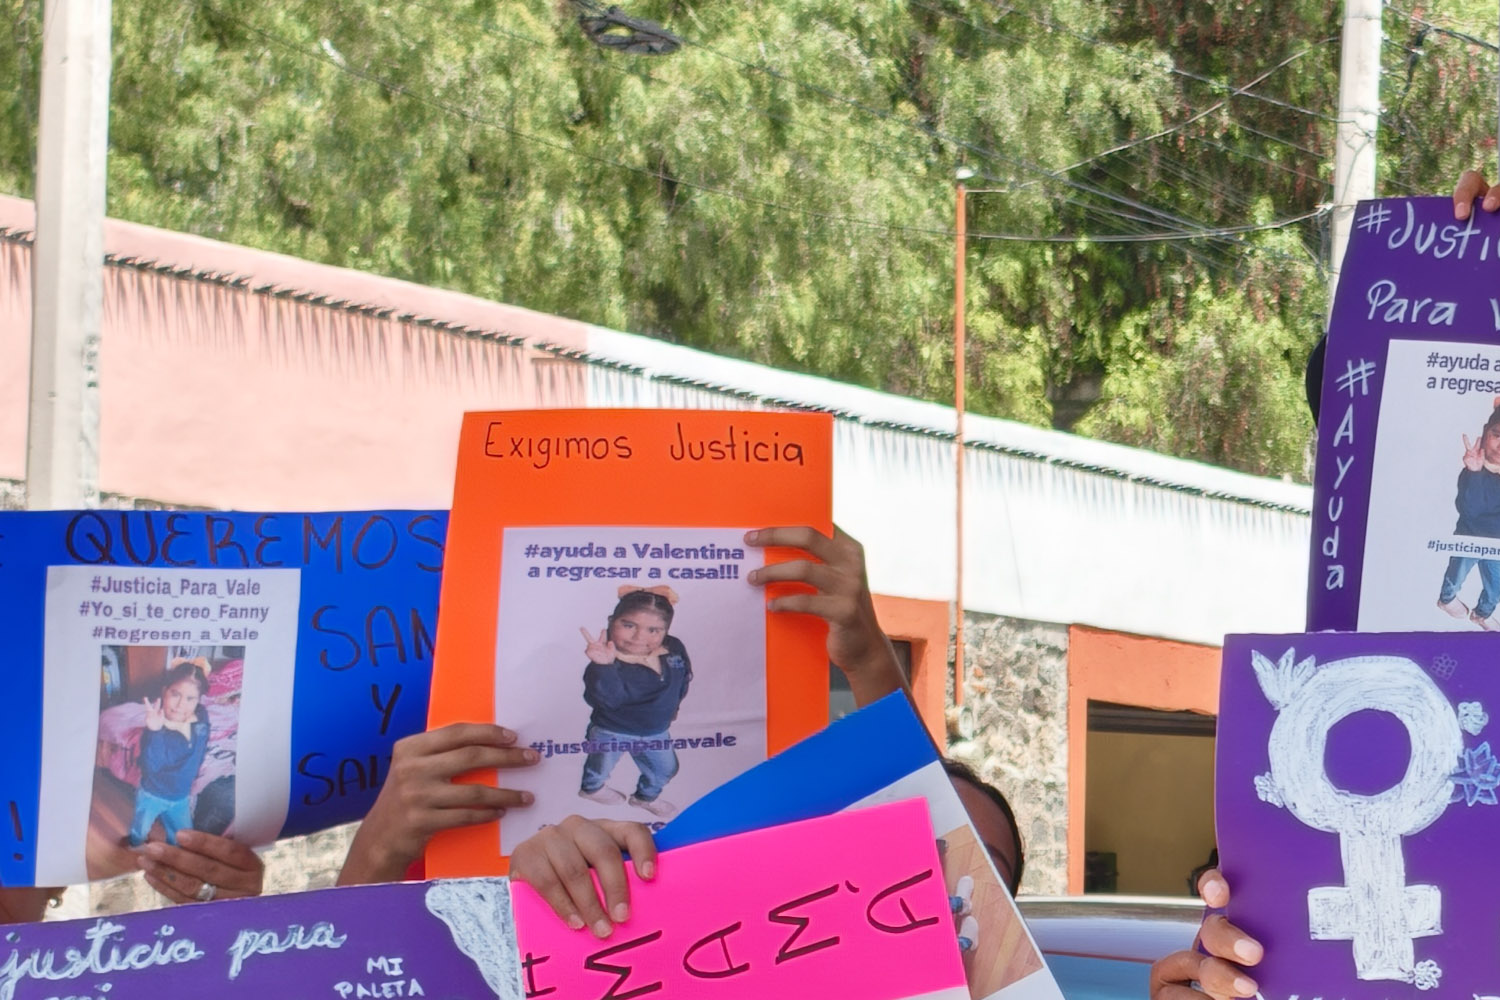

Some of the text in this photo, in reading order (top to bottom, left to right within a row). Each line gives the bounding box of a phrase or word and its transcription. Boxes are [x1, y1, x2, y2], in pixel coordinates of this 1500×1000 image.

[1367, 279, 1459, 326] Para
[1426, 351, 1489, 373] #ayuda
[1426, 376, 1437, 389] a
[484, 421, 805, 470] Exigimos Justicia
[65, 510, 444, 573] QUEREMOS
[524, 542, 745, 562] #ayuda a Valentina
[527, 564, 740, 582] a regresar a casa!!!
[91, 575, 262, 599] #Justicia_Para_Vale
[79, 601, 270, 624] #Yo_si_te_creo_Fanny
[92, 626, 260, 644] #Regresen_a_Vale
[311, 604, 436, 672] SAN
[370, 683, 403, 736] Y
[530, 732, 737, 758] #justiciaparavale
[227, 920, 348, 981] para
[365, 955, 405, 977] MI
[333, 977, 425, 1000] PALETA
